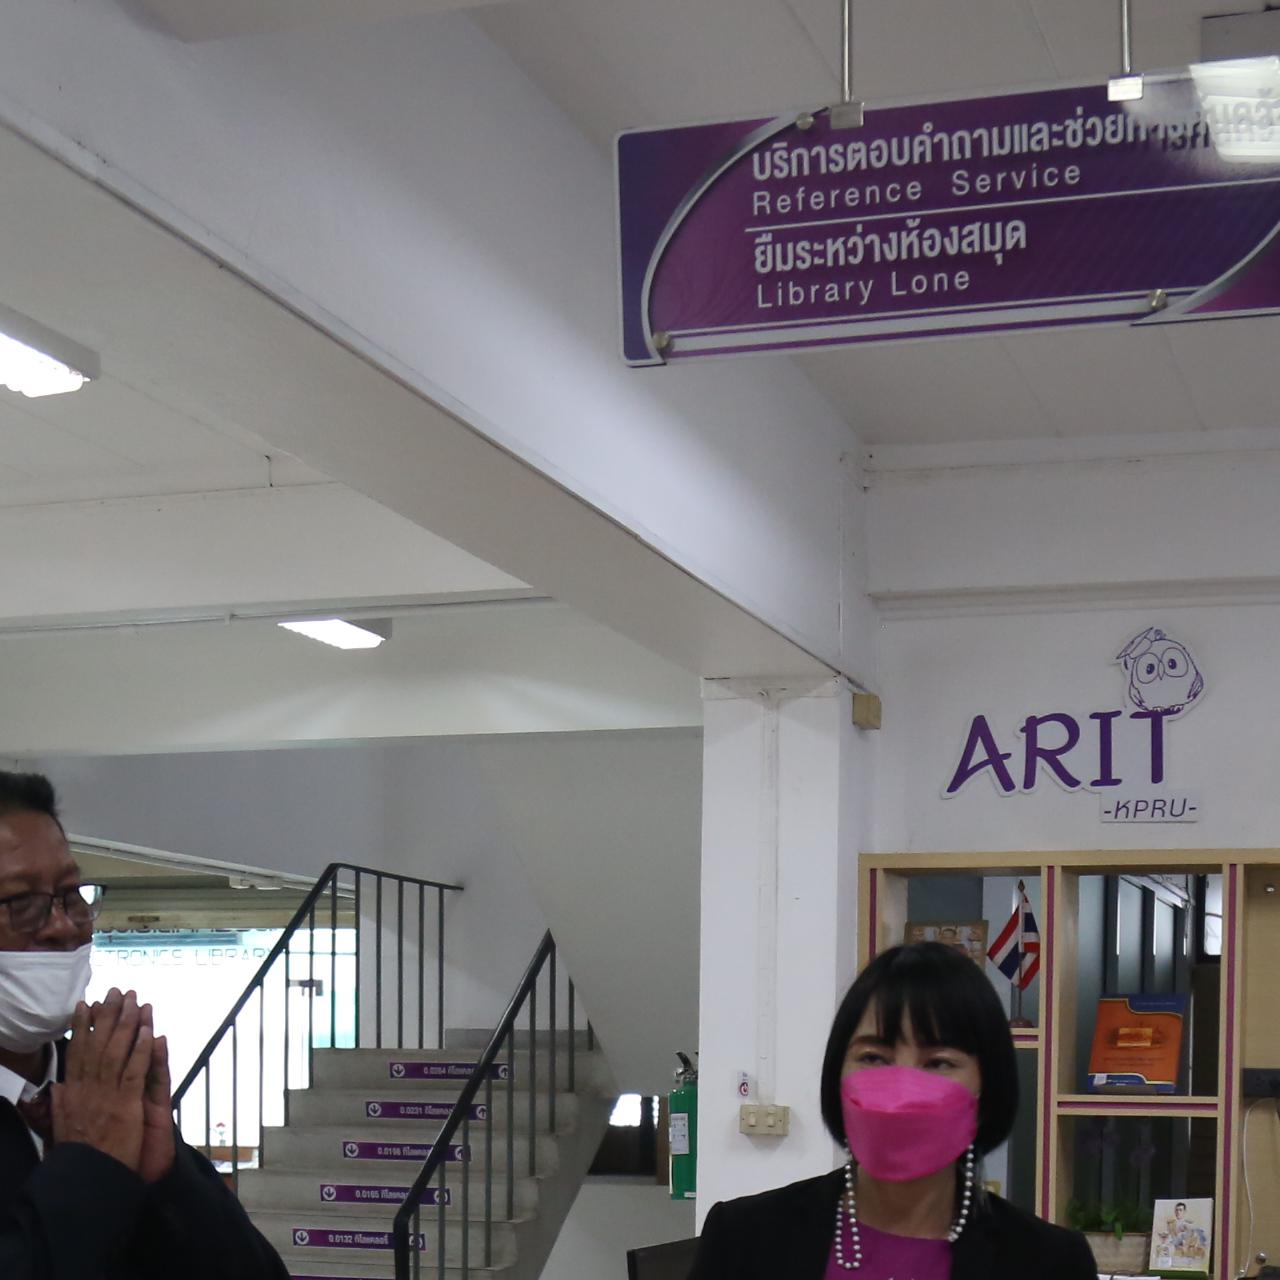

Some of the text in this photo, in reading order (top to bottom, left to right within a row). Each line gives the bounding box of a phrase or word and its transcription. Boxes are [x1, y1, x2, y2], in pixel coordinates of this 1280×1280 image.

[752, 162, 1082, 216] Reference Service
[754, 217, 1028, 274] ยืมระหว่างห้องสมุด
[756, 269, 971, 309] Library Lone
[946, 709, 1185, 793] ARIT
